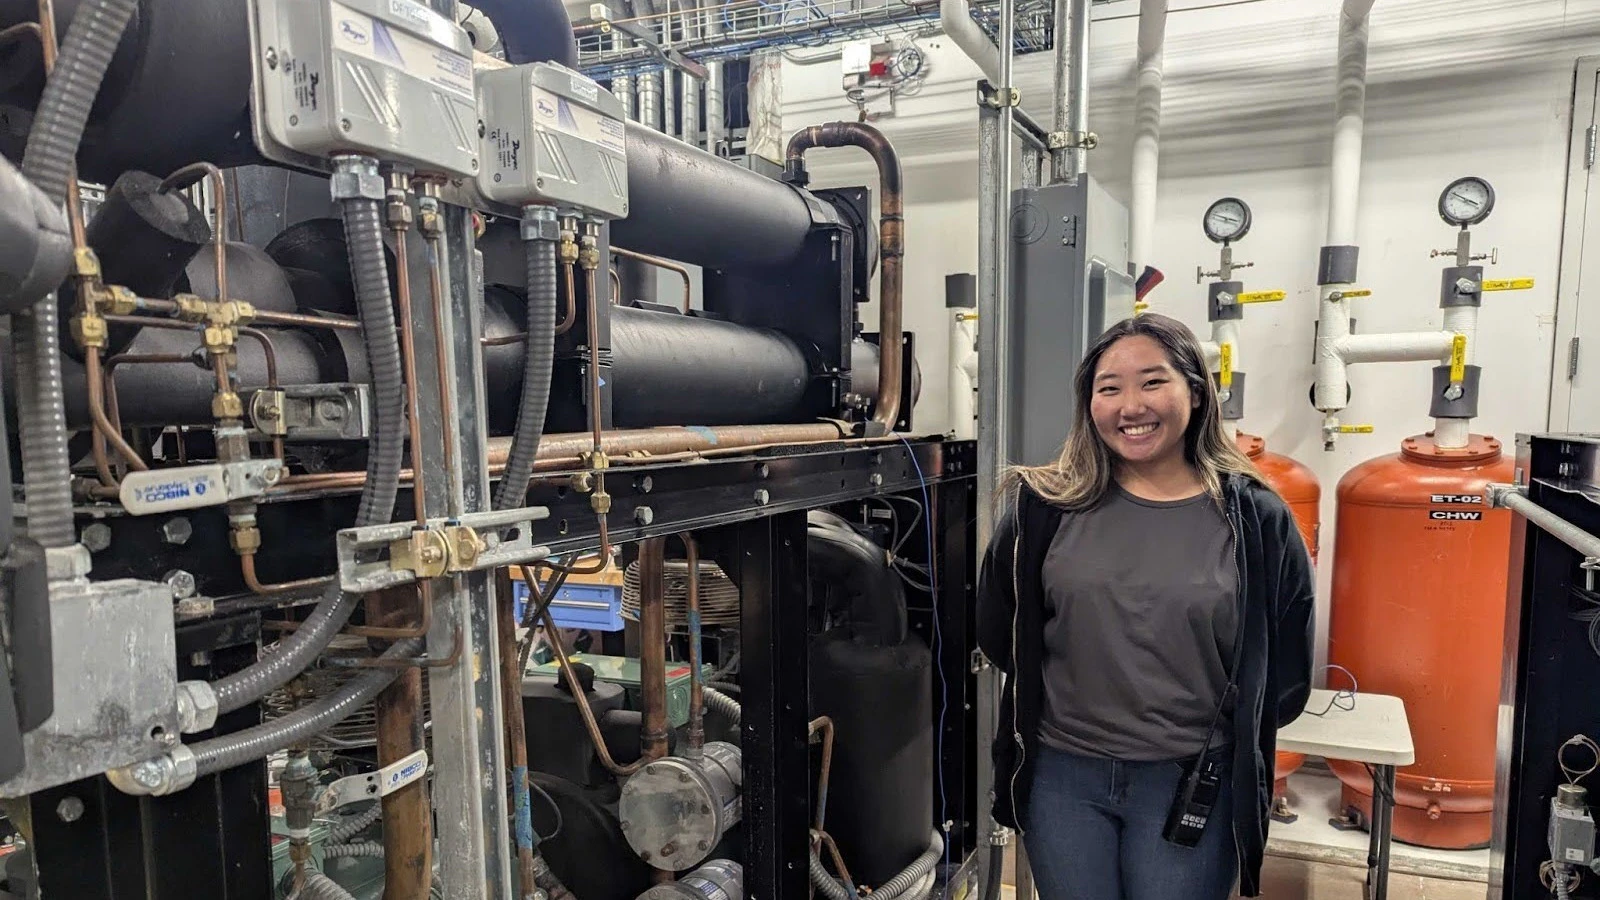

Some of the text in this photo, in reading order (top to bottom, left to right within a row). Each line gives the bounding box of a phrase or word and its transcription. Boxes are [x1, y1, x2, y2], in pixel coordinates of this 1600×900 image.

[511, 139, 521, 171] Dwyer
[146, 488, 190, 503] NIBCO
[1432, 512, 1479, 520] CHW
